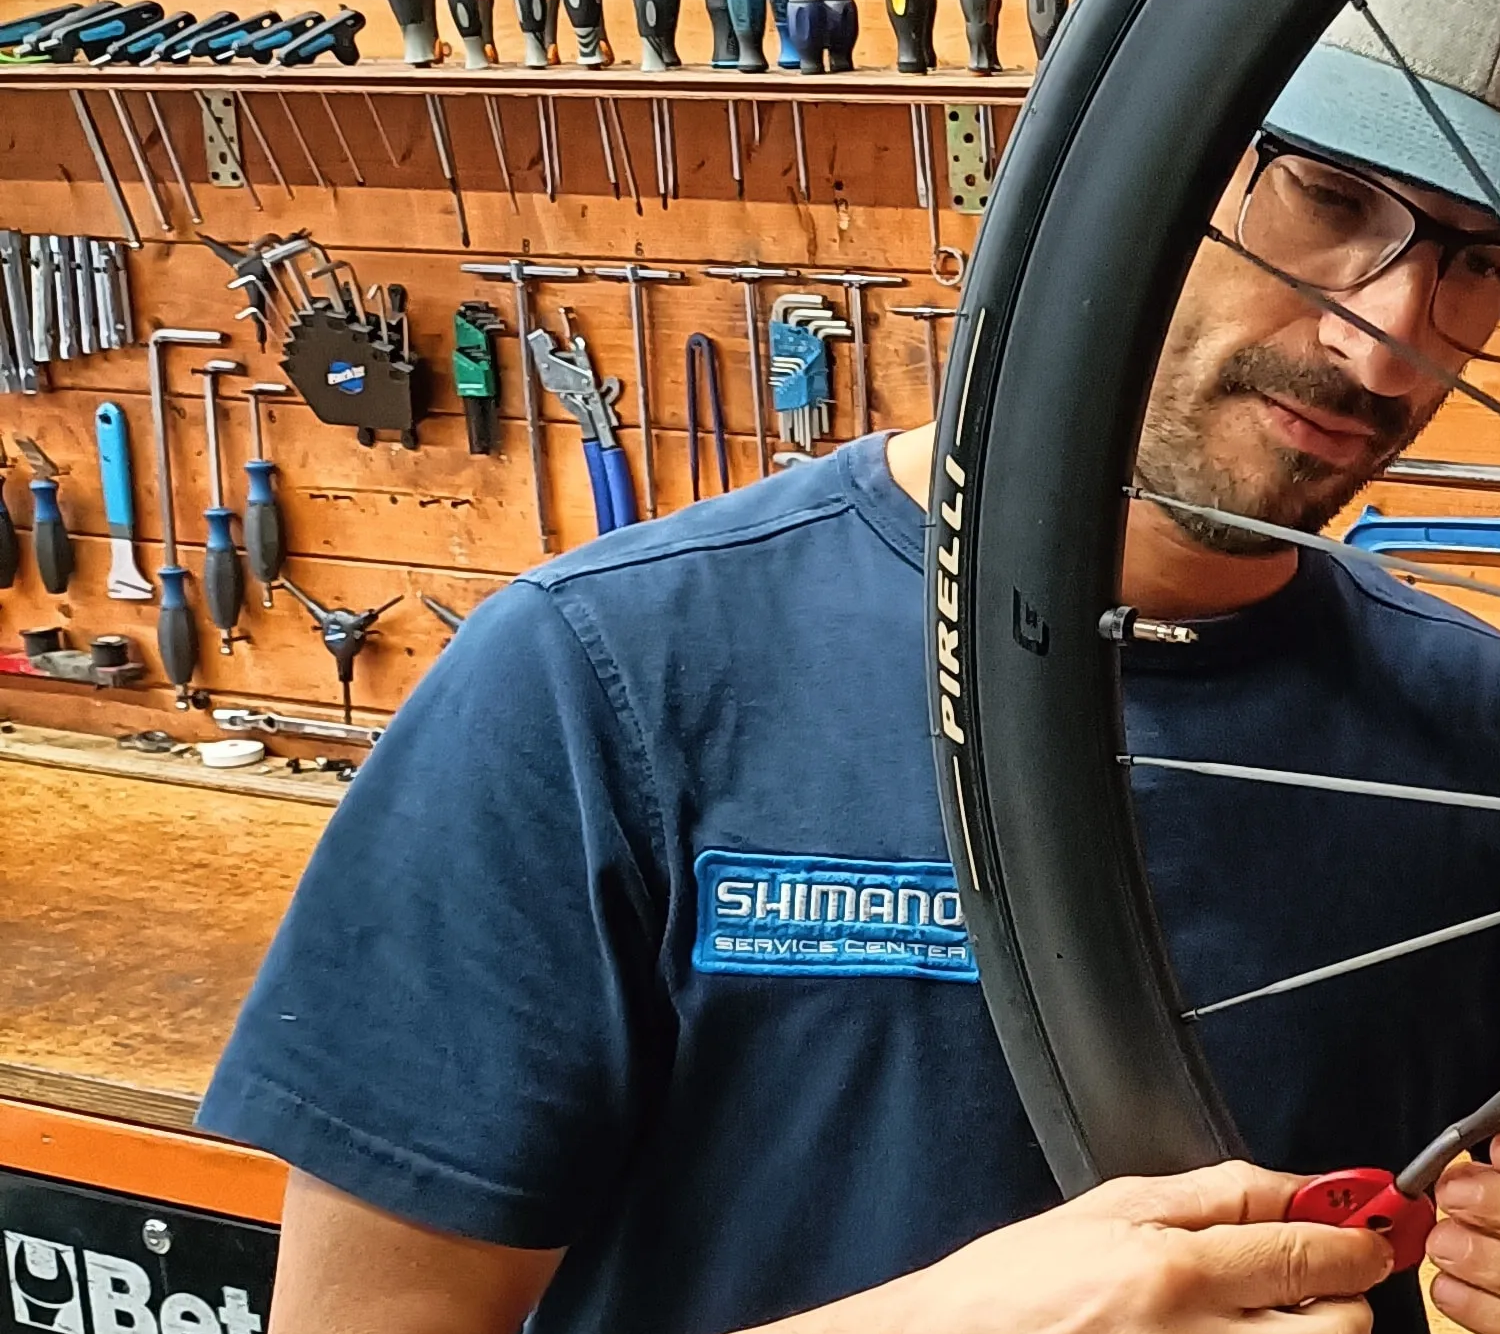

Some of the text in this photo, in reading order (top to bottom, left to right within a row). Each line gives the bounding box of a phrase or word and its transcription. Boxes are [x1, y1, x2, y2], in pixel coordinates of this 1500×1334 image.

[939, 456, 969, 746] PIRELLI
[717, 880, 965, 926] SHIMANO
[714, 936, 966, 960] SERVICE CENTER
